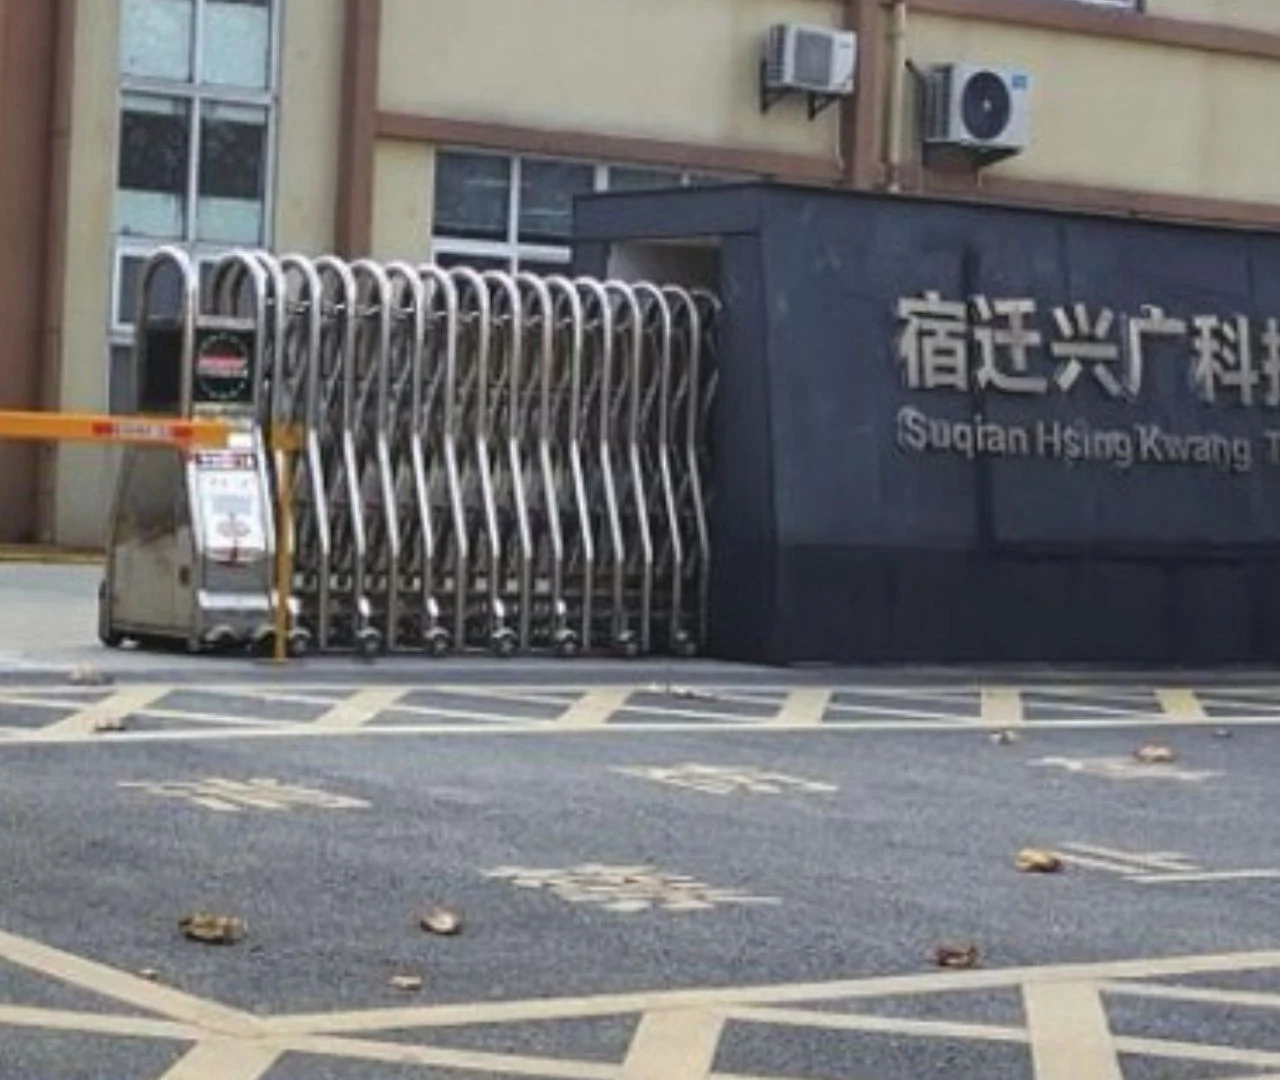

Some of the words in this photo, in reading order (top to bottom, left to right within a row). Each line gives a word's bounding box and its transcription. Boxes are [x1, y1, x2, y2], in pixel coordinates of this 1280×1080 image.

[897, 407, 1028, 458] Suqian
[1036, 418, 1134, 468] Hsing
[1134, 422, 1252, 472] Kwang
